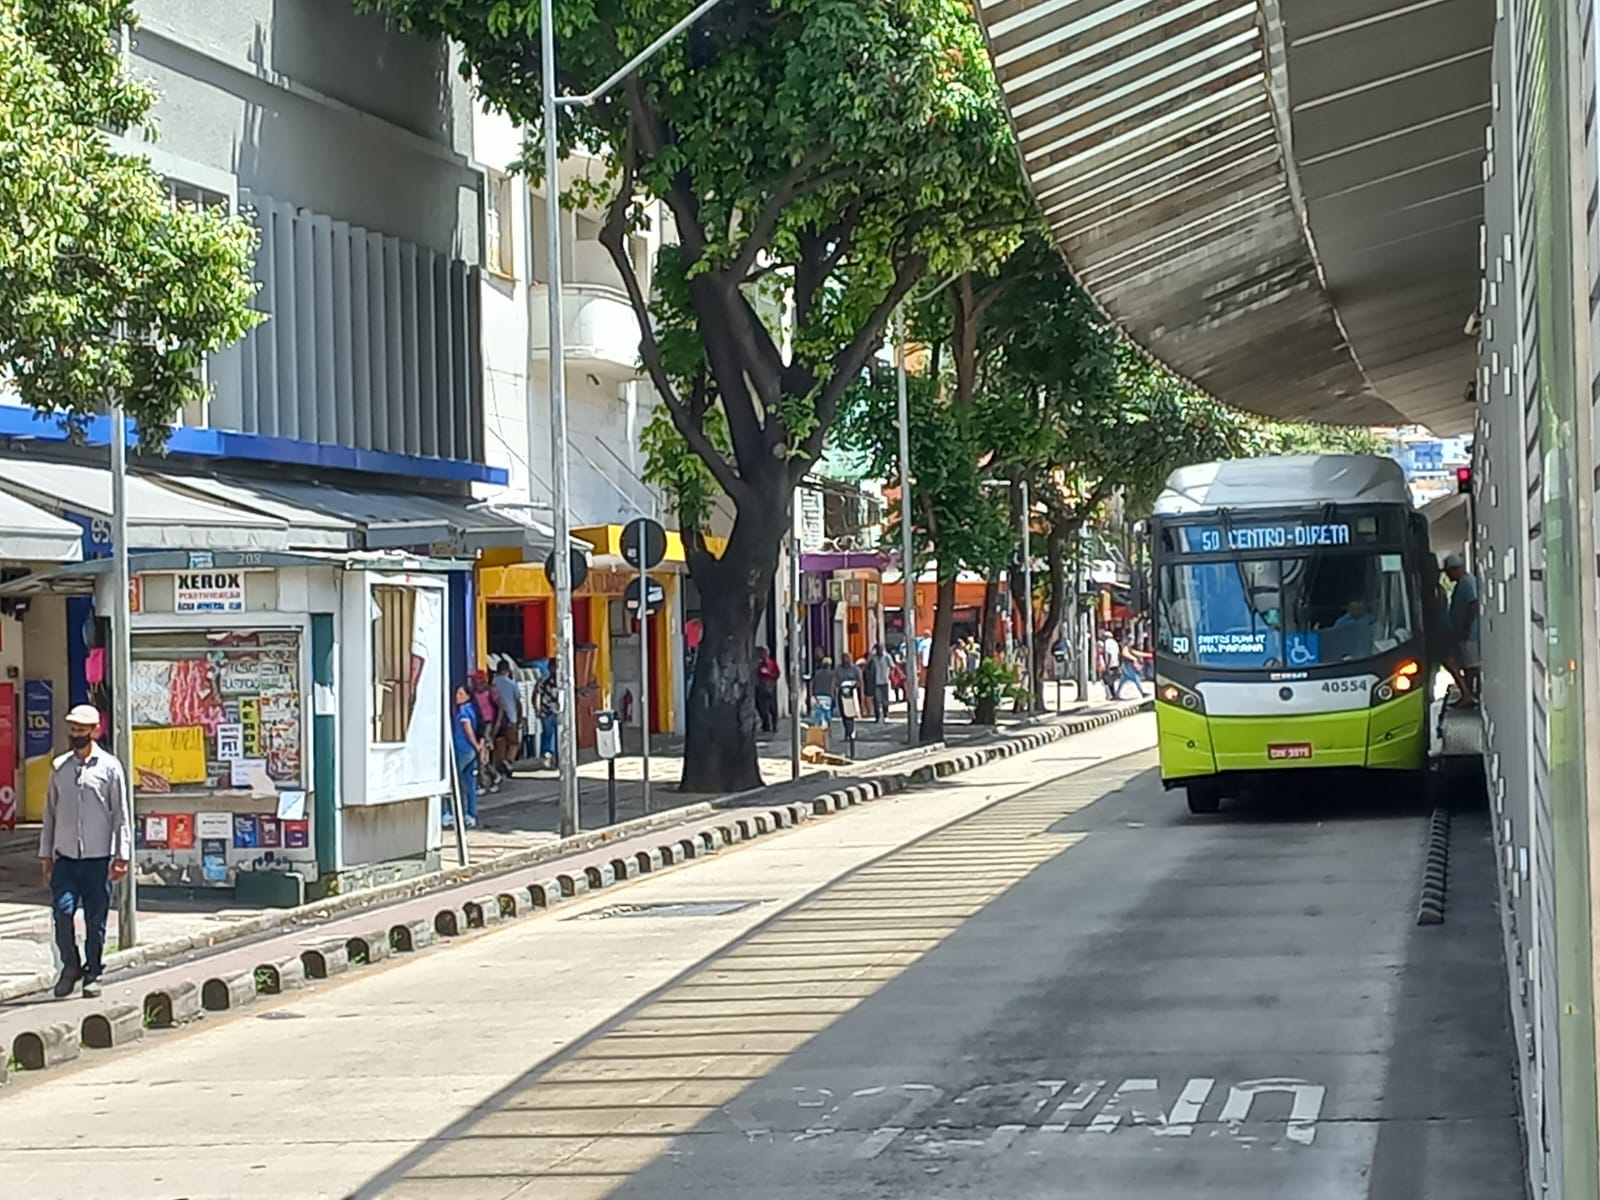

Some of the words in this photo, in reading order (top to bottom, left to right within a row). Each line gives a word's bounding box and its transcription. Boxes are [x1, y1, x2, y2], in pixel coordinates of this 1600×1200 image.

[1202, 531, 1220, 551] 50
[178, 574, 240, 590] XEROX
[1173, 637, 1189, 654] 50
[1321, 680, 1368, 693] 40554
